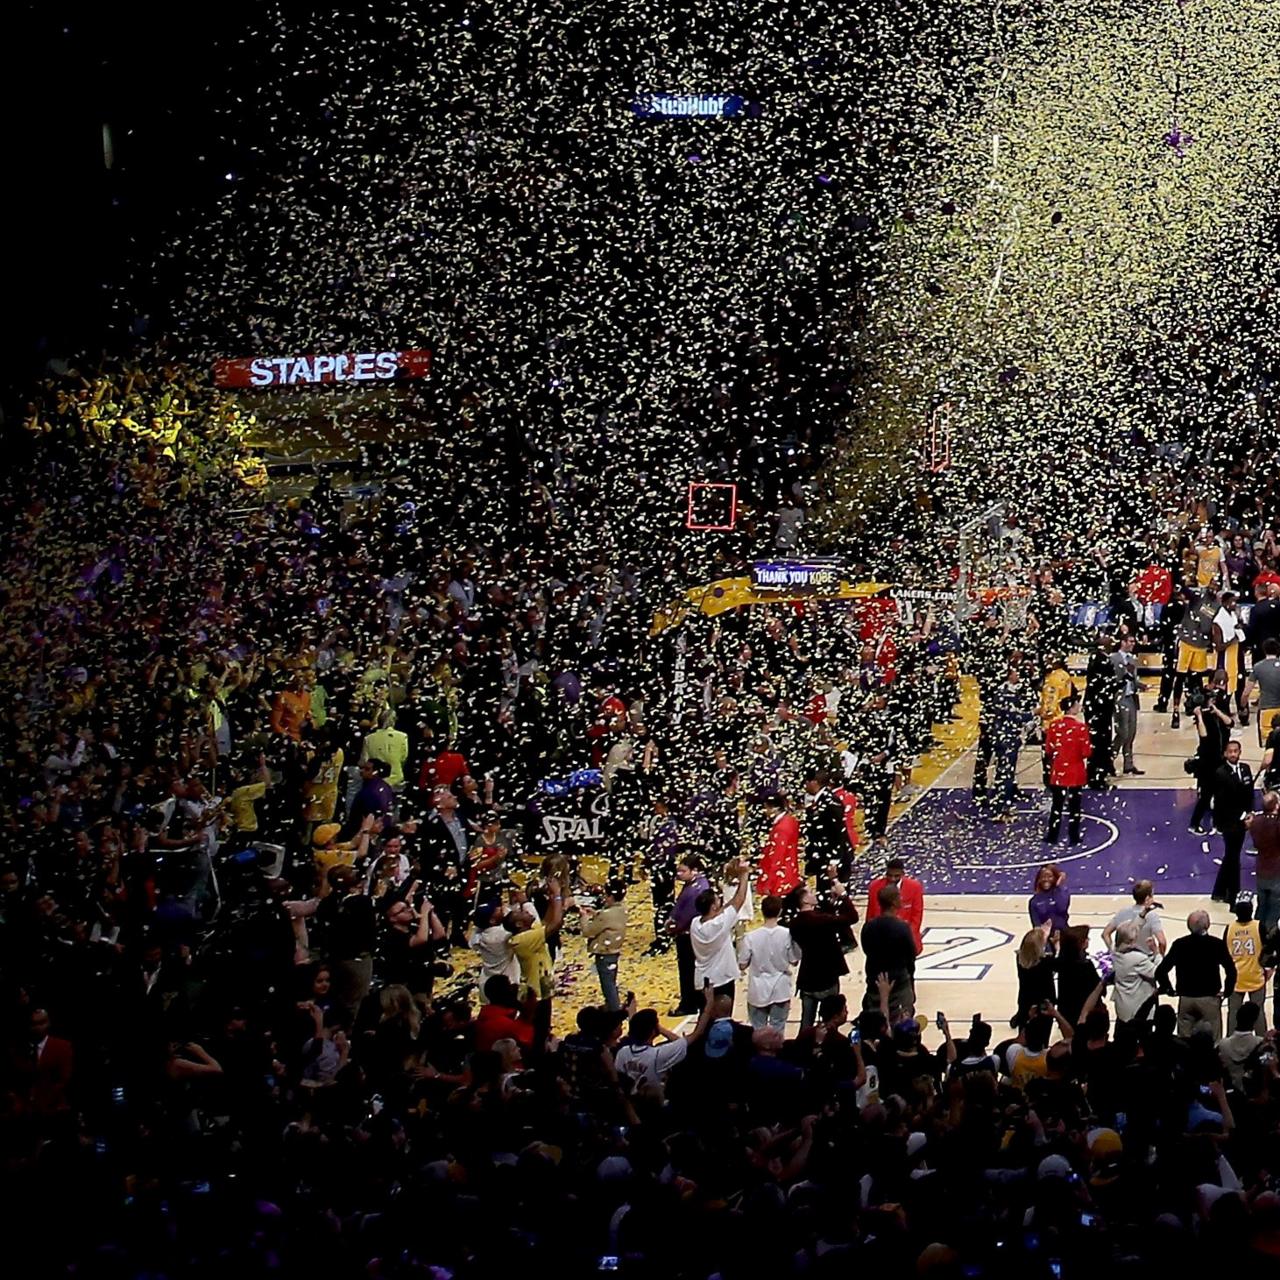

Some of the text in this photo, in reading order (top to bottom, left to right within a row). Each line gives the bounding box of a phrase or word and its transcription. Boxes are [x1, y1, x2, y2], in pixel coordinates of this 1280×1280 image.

[651, 96, 724, 115] StubHub!
[250, 352, 399, 385] STAPLES
[757, 570, 834, 585] THANK YOU KOBE
[541, 815, 605, 845] SPAL
[1231, 938, 1255, 956] 24
